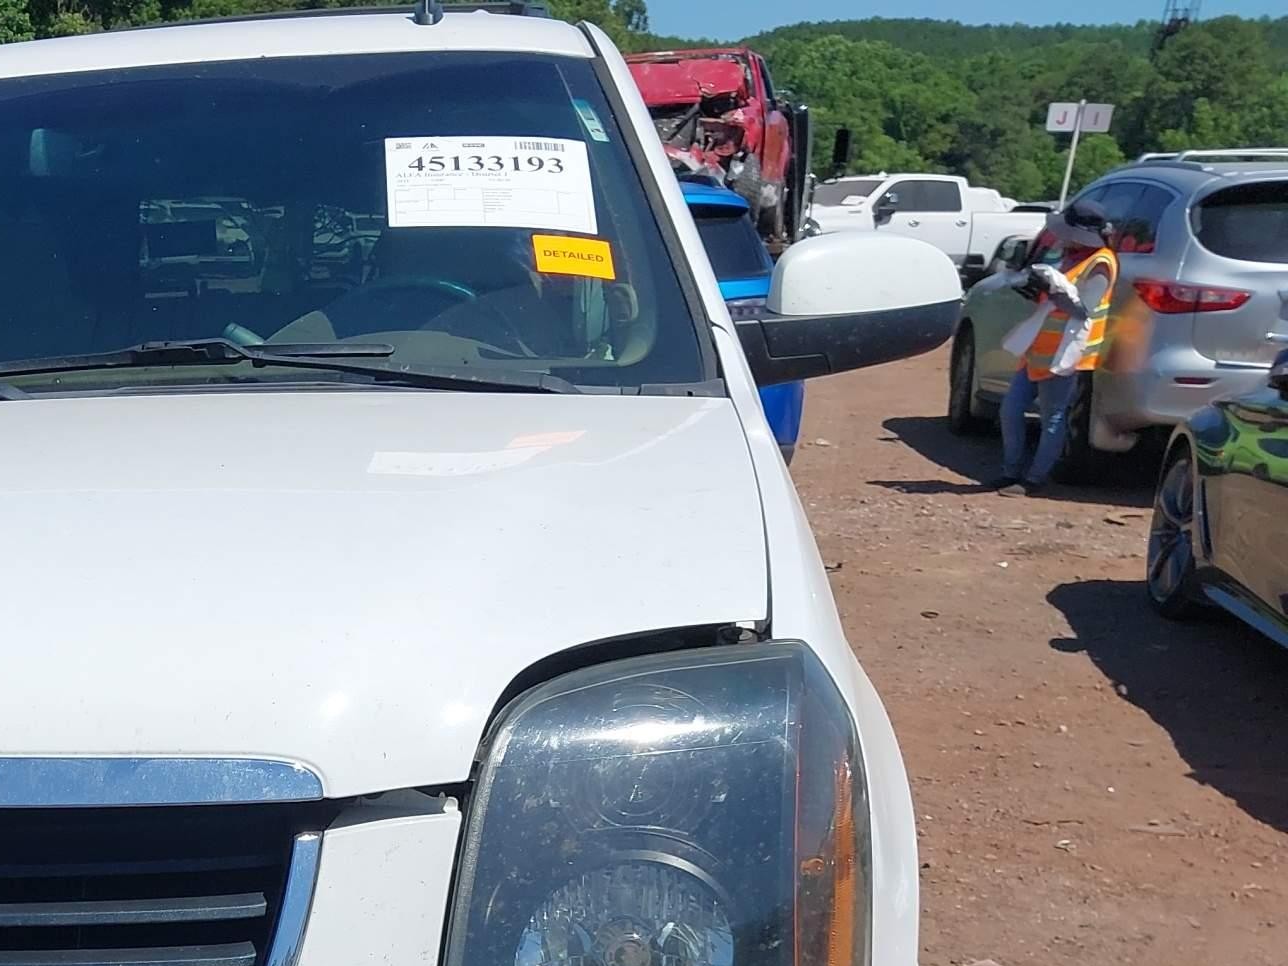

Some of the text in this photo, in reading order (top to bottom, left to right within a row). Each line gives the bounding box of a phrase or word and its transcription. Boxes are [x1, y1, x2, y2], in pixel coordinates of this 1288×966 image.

[1056, 111, 1067, 125] J
[408, 155, 564, 174] 45133193
[543, 249, 604, 263] DETAILED
